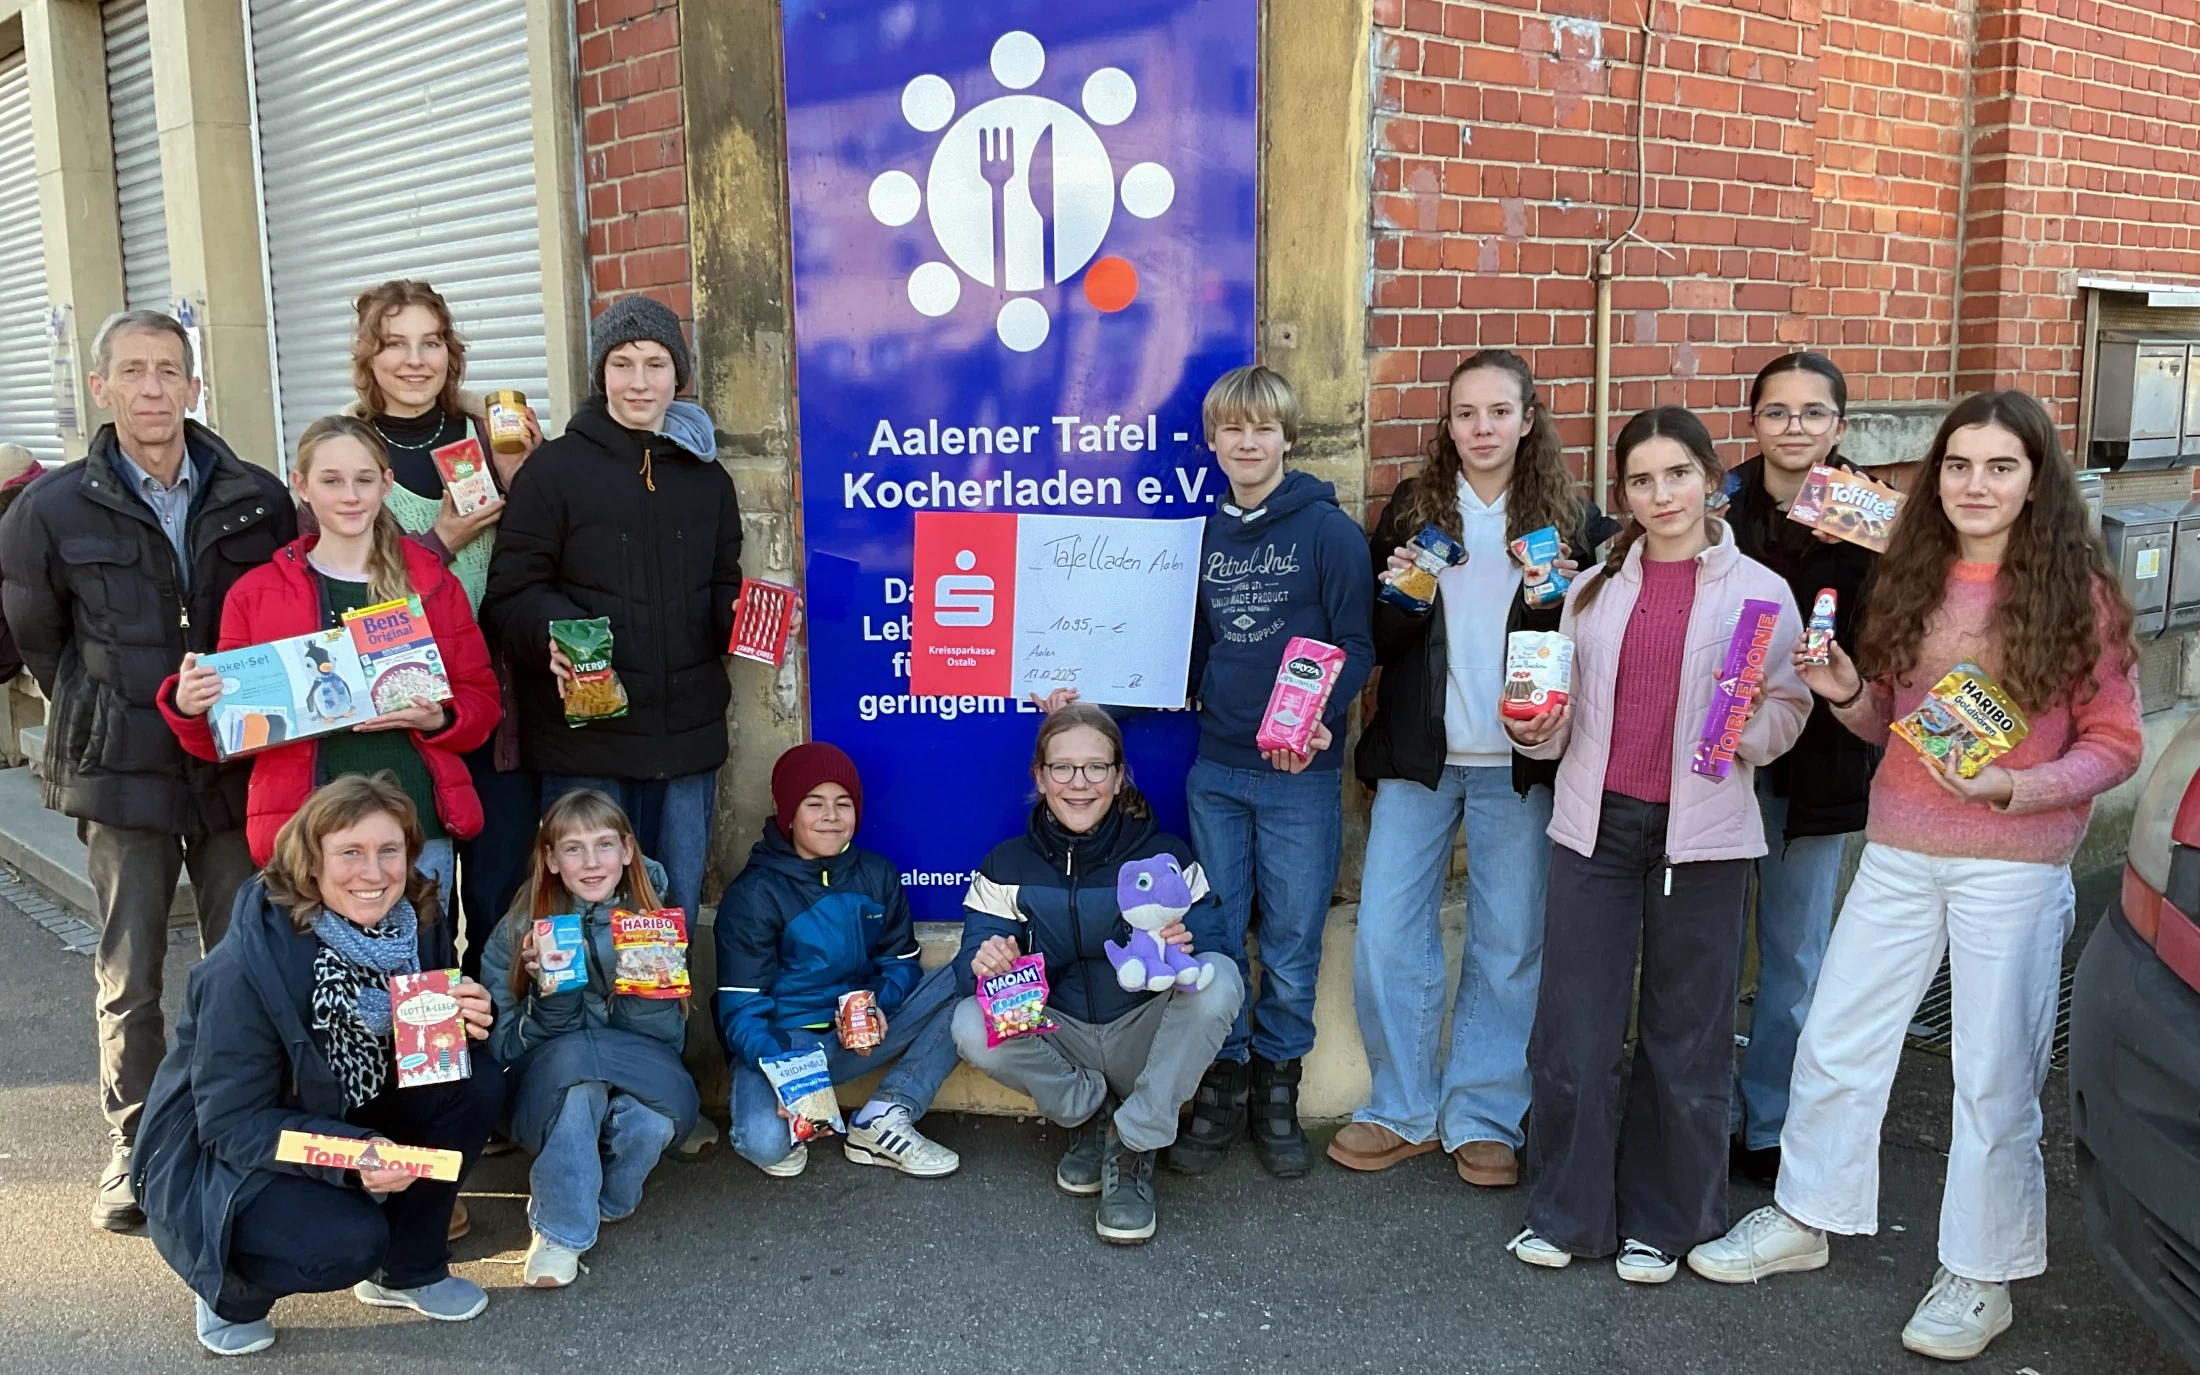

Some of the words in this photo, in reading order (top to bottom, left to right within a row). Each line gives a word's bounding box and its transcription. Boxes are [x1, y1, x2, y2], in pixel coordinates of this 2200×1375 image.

[868, 418, 1040, 456] Aalener
[1052, 414, 1157, 453] Tafel
[843, 470, 1122, 509] Kocherladen
[1137, 467, 1214, 505] e.V.
[1829, 482, 1897, 521] Toffifee
[1044, 534, 1141, 580] Tafelladen
[1252, 591, 1289, 604] PRODUCT
[362, 610, 410, 635] Ben's
[368, 624, 414, 645] Original
[1248, 617, 1286, 643] SUPPLIES
[928, 645, 996, 657] Kreissparkasse
[947, 657, 977, 667] Ostalb
[1290, 662, 1319, 675] ORYZA
[1710, 613, 1780, 764] TOBLERONE
[859, 694, 1005, 721] geringem
[1954, 695, 1997, 737] Goldbären
[1960, 679, 2014, 732] HARIBO
[622, 917, 674, 931] HARIBO
[985, 967, 1038, 996] MAOAM
[459, 1050, 468, 1077] KOSMOS
[780, 1059, 826, 1078] ERIDANOUS
[1972, 1301, 1985, 1317] FILA
